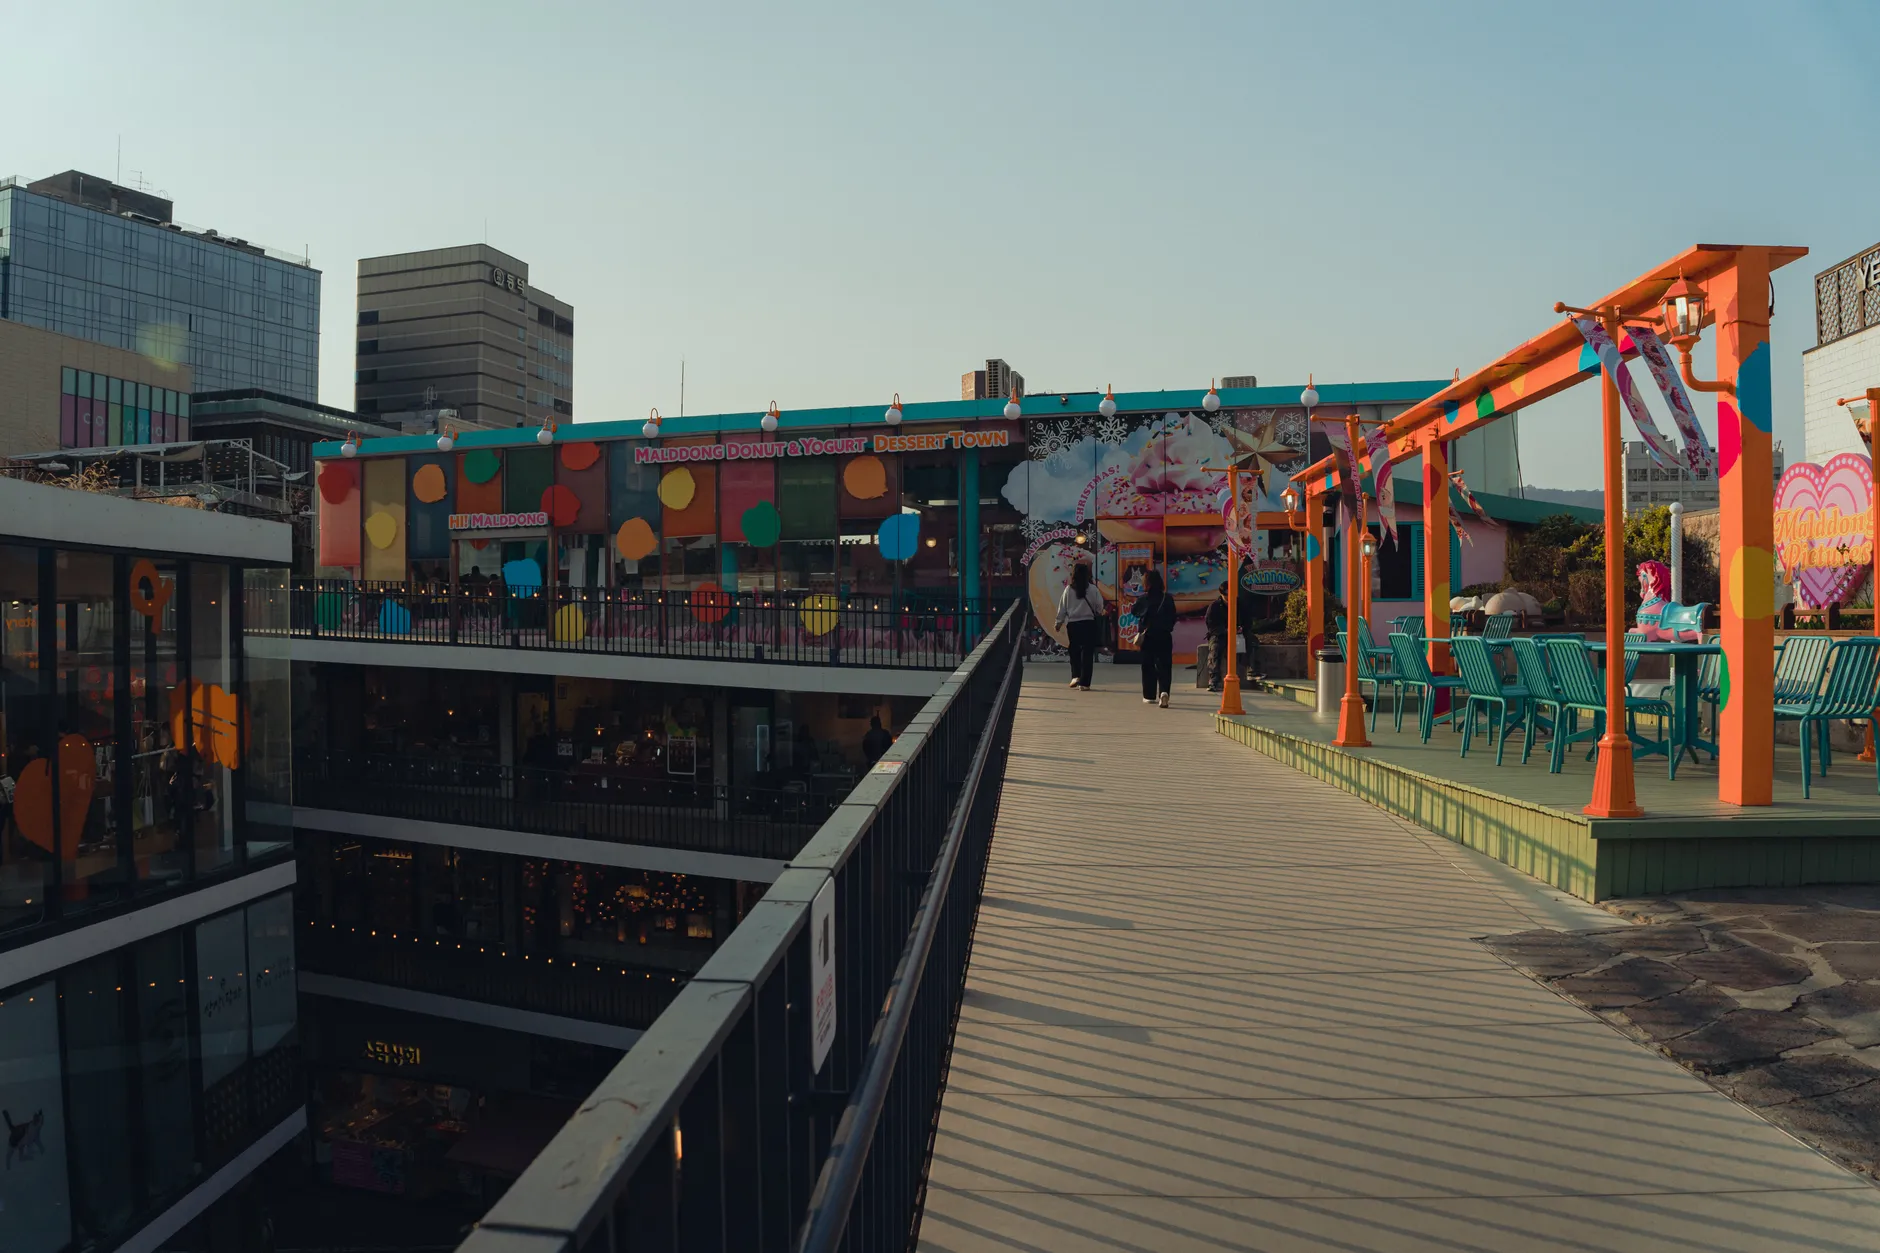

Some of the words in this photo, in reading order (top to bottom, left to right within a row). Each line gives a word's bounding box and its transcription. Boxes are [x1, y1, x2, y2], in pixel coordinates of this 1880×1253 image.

[507, 273, 525, 296] 동덕
[635, 444, 724, 464] MALDDONG
[726, 441, 786, 460] DONUT
[787, 441, 804, 456] &
[801, 436, 868, 455] YOGURT
[873, 433, 948, 453] DESSERT
[949, 430, 1008, 449] TOWN
[1076, 464, 1120, 523] CHRISTMAS!
[449, 514, 469, 529] HI!
[471, 512, 547, 528] MALDDONG
[1773, 505, 1874, 544] Malddong
[1020, 528, 1078, 566] MALDDONG
[1783, 540, 1873, 586] Pictures
